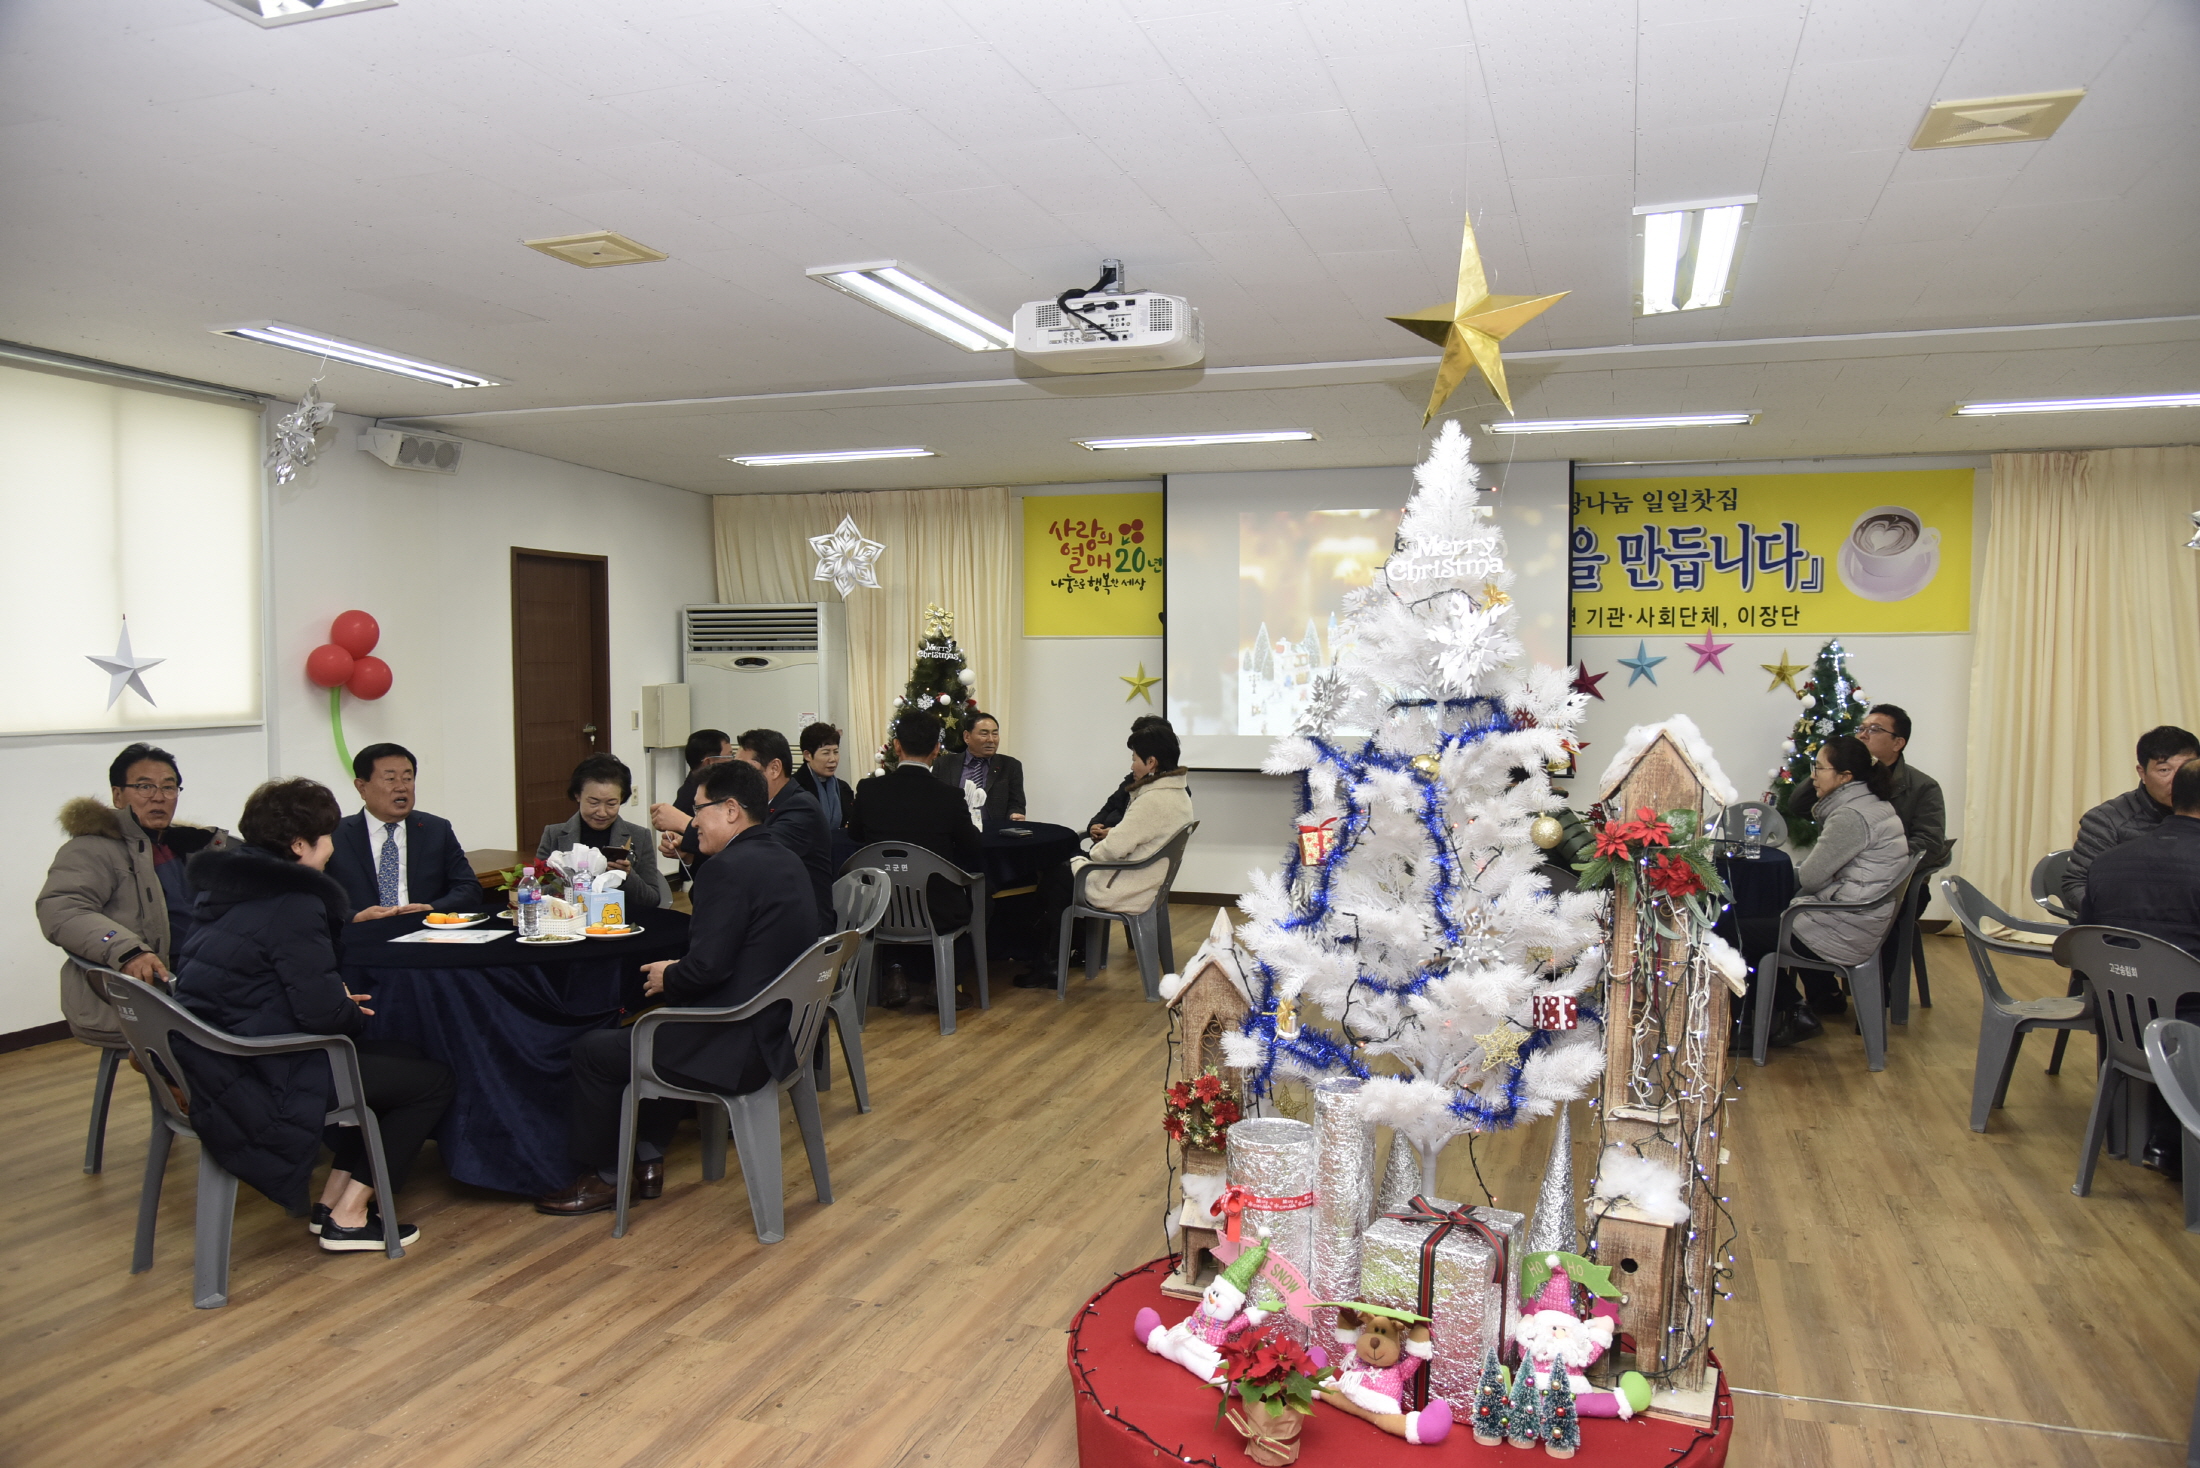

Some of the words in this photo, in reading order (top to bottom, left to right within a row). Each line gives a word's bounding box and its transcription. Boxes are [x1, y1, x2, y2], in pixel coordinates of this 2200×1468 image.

[1642, 487, 1738, 513] 일일찻집
[1049, 518, 1113, 551] 사랑의
[1412, 534, 1496, 560] Merry
[1060, 542, 1112, 574] 열매
[1051, 574, 1086, 593] 나눔으로
[1087, 572, 1119, 595] 행복한
[1121, 577, 1147, 592] 세상
[1737, 605, 1800, 628] 이장단
[1270, 1263, 1302, 1294] SNOW
[1526, 1260, 1544, 1278] HO
[1566, 1260, 1584, 1277] HO
